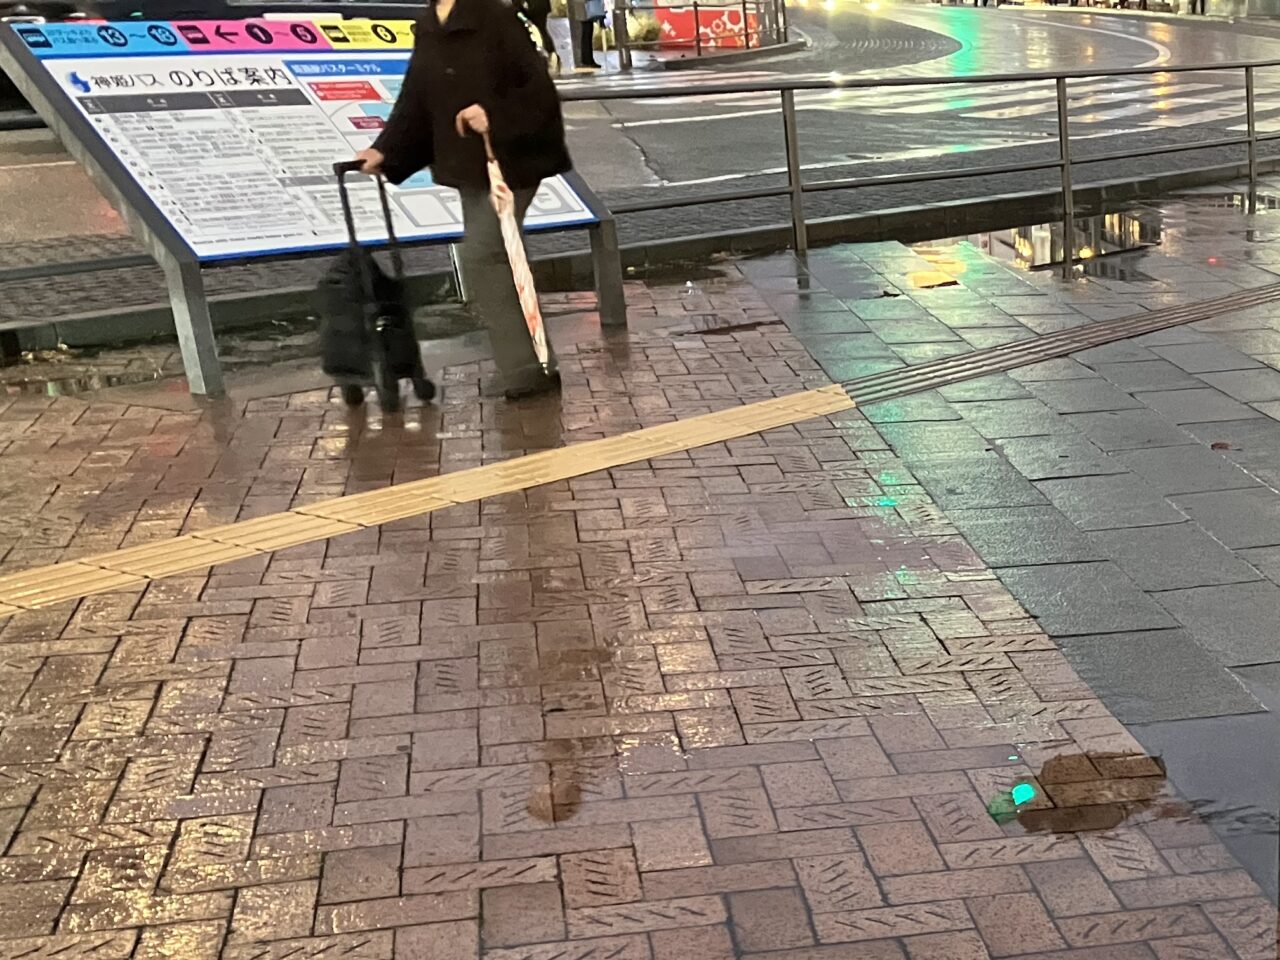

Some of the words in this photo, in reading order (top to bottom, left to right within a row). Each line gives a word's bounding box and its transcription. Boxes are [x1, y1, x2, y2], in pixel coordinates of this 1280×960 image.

[99, 27, 126, 44] 13
[91, 73, 165, 88] 神姫バス
[169, 66, 292, 87] のりば案内
